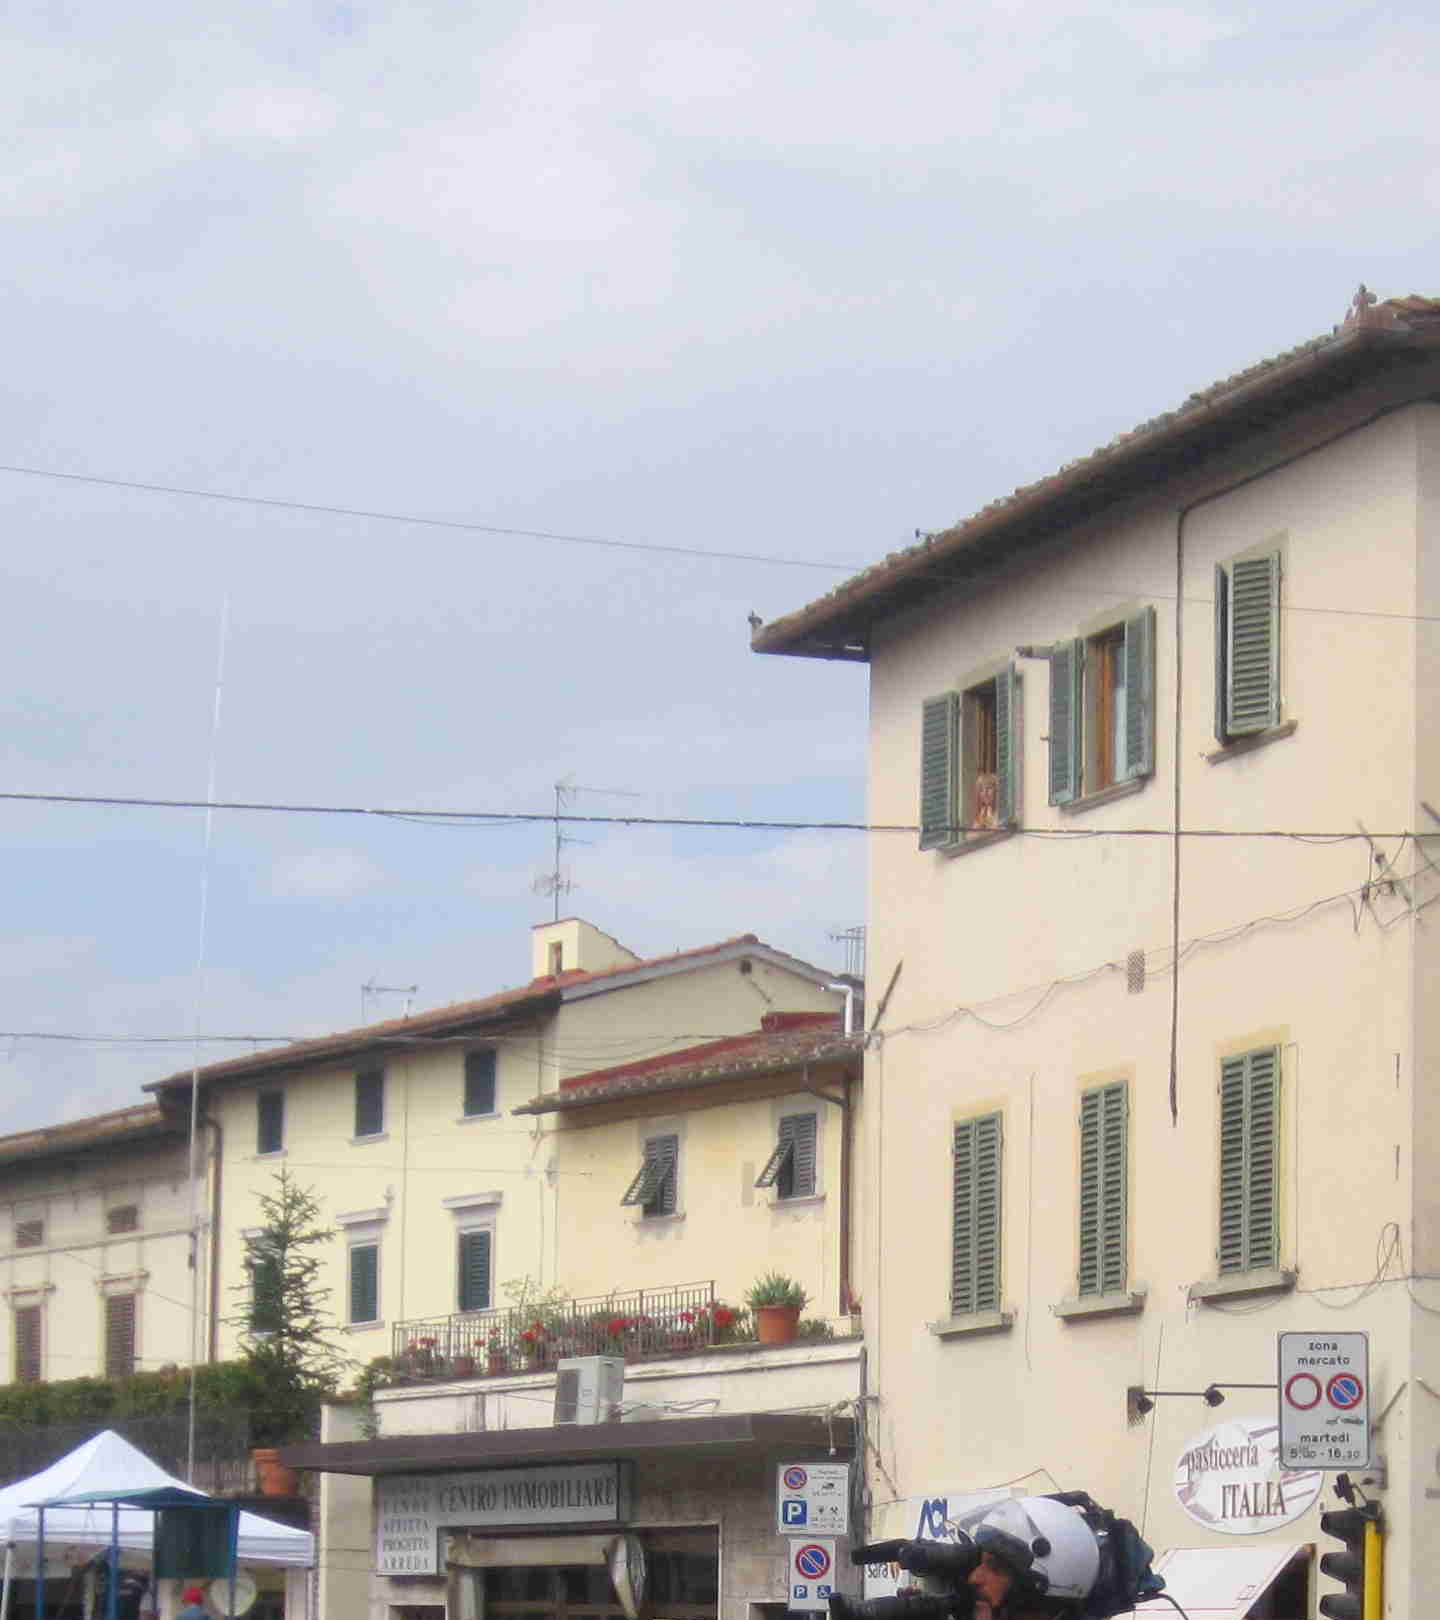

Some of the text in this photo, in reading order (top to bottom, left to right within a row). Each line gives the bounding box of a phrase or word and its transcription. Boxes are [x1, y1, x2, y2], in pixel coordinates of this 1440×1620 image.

[1297, 1353, 1351, 1366] mercato
[1308, 1340, 1339, 1352] zona
[1186, 1439, 1259, 1481] pasticceria
[438, 1482, 498, 1513] CENTRO
[502, 1475, 617, 1510] IMMOBILIARE
[1221, 1480, 1288, 1519] ITALIA
